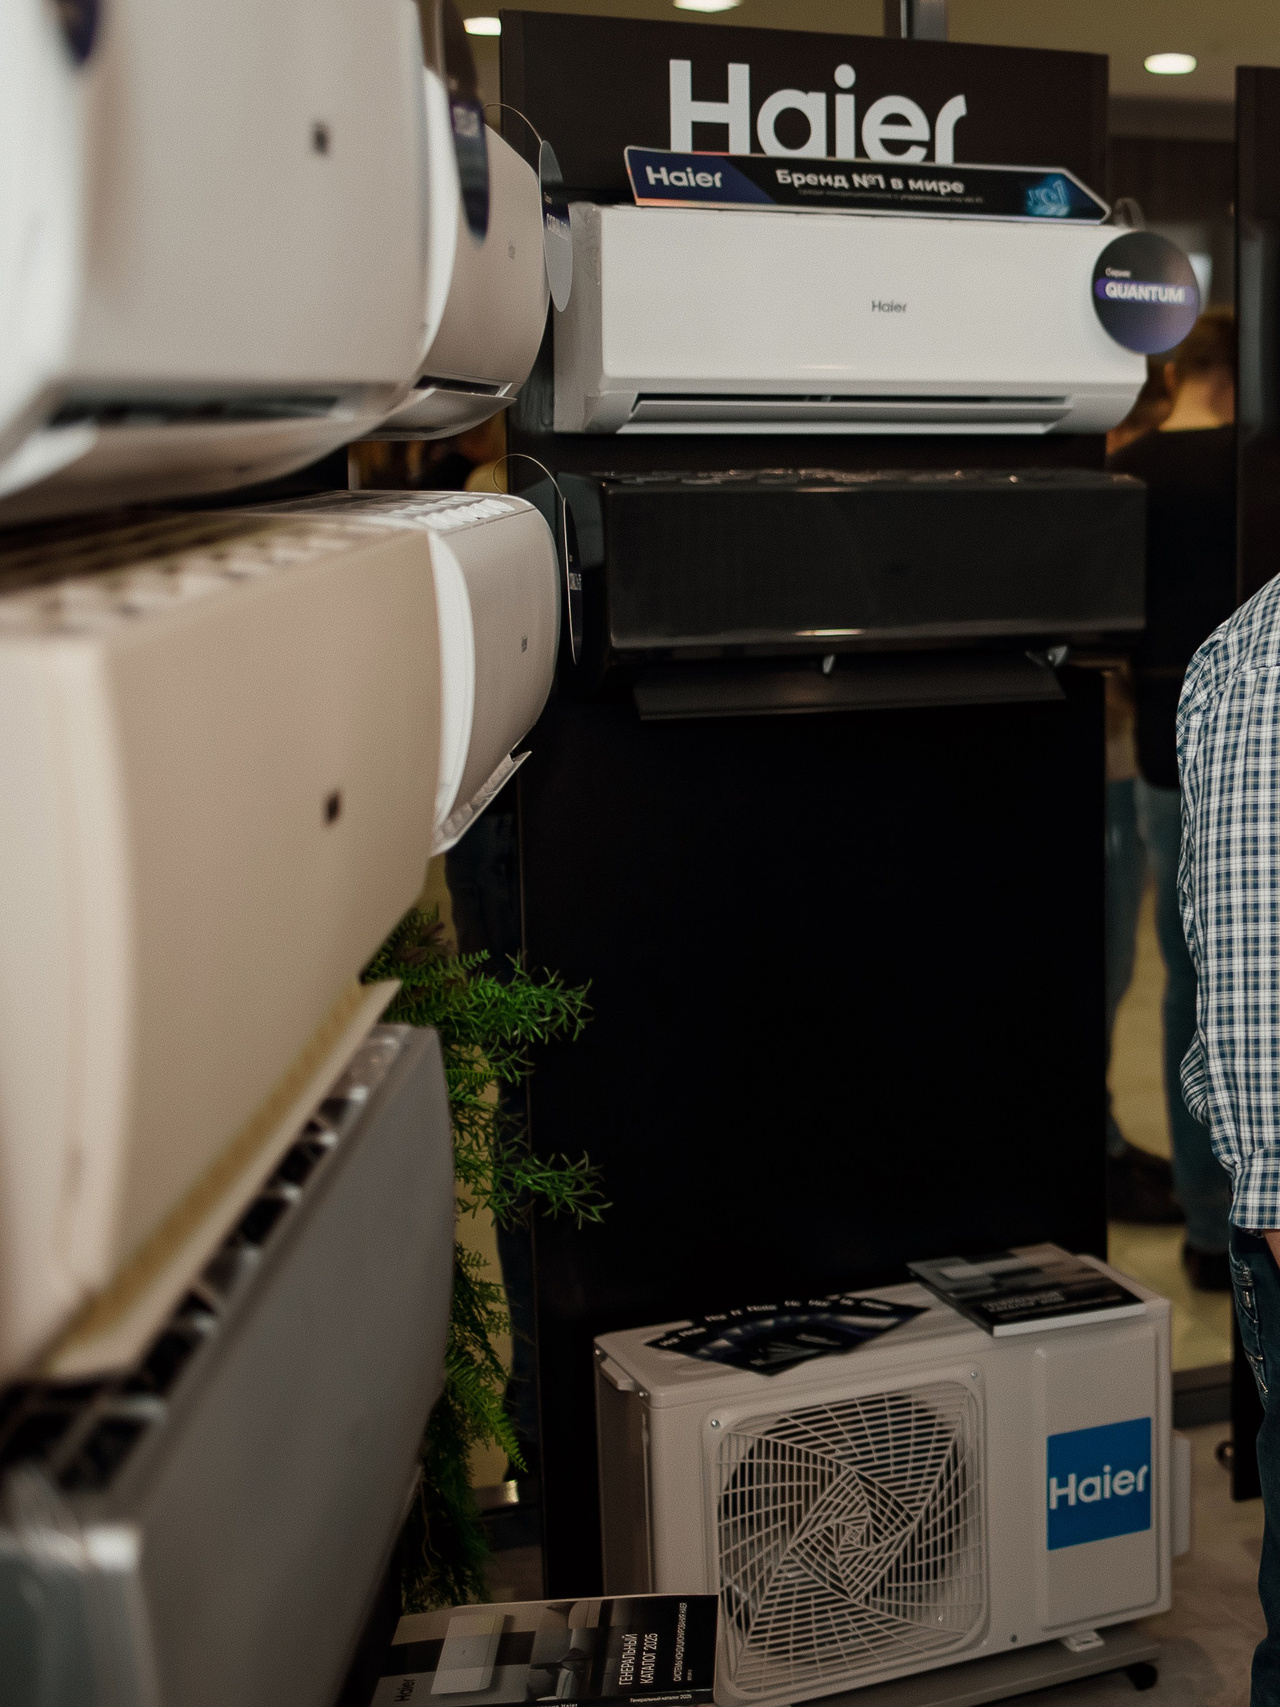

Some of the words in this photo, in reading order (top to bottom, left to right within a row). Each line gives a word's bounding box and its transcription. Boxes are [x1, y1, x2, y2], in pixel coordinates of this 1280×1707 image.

[669, 59, 967, 165] Haier
[645, 165, 723, 189] Haier
[775, 168, 849, 191] Бренд
[852, 173, 886, 190] №1
[891, 176, 904, 191] в
[907, 178, 966, 196] мире
[1104, 281, 1185, 304] QUANTUM
[871, 300, 908, 313] Haier
[1048, 1464, 1148, 1511] Haier
[643, 1633, 659, 1650] 2025
[618, 1633, 638, 1686] ГЕНЕРАЛЬНЫЙ
[640, 1651, 657, 1684] КАТАЛОГ
[395, 1679, 416, 1702] Haier
